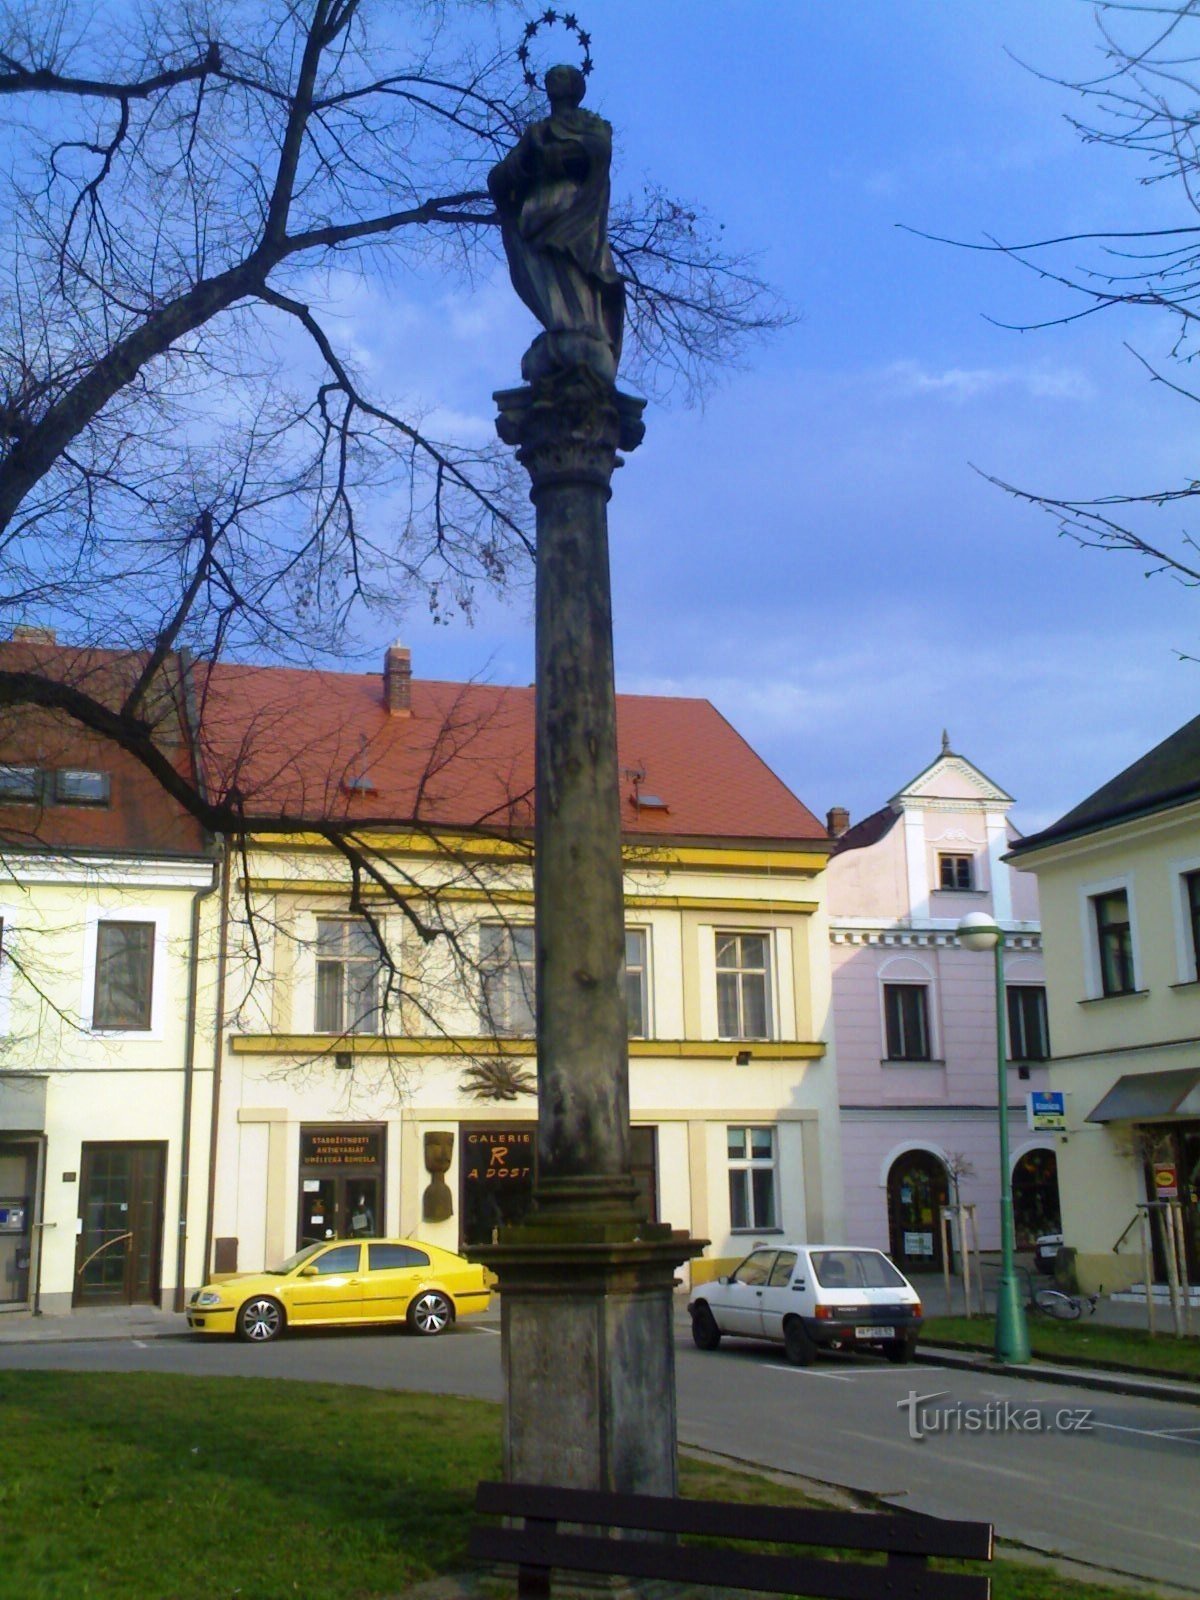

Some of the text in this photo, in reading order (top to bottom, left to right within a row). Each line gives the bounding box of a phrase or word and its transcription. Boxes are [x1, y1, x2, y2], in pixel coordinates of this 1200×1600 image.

[468, 1134, 530, 1144] GALERIE
[490, 1146, 508, 1166] R
[467, 1168, 530, 1178] A DOST
